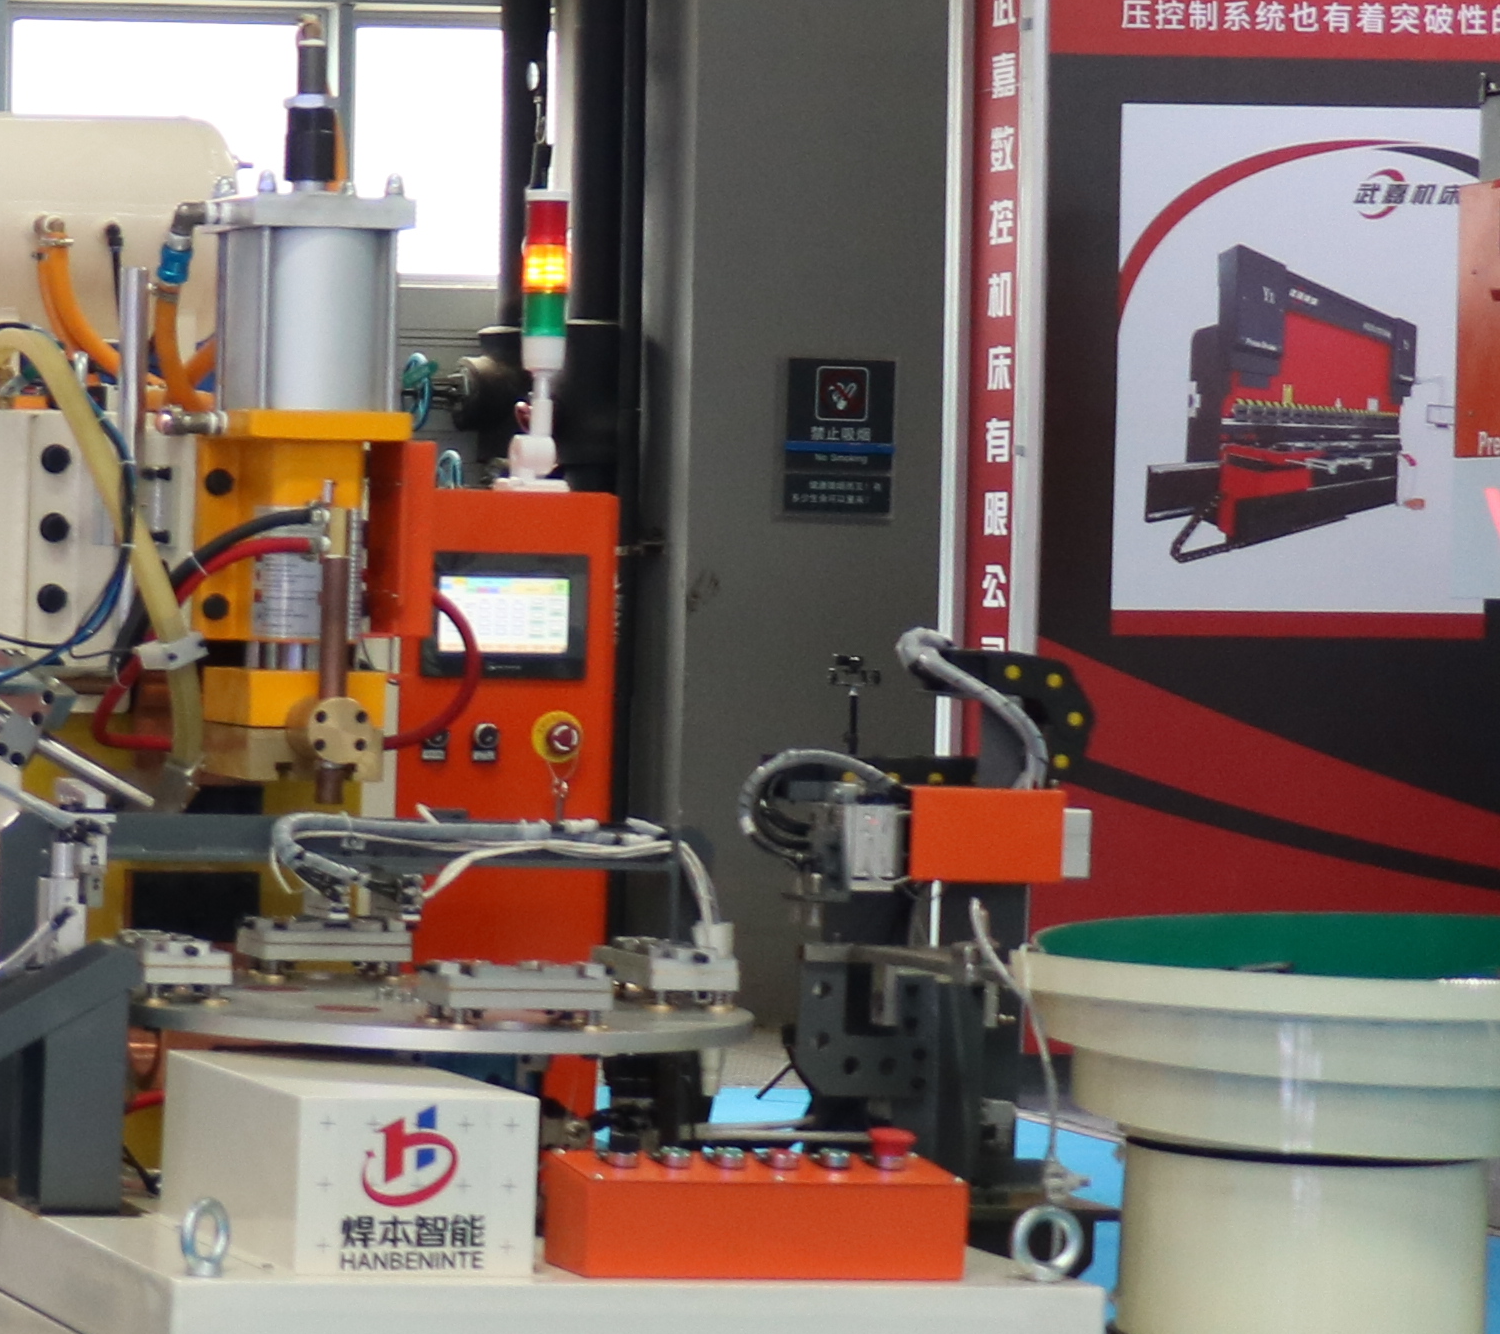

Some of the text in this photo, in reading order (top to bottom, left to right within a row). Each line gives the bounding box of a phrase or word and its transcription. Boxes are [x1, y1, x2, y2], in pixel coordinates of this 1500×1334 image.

[810, 426, 871, 442] 禁止吸烟
[340, 1214, 486, 1250] 焊本智能
[340, 1250, 485, 1271] HANBENINTE
